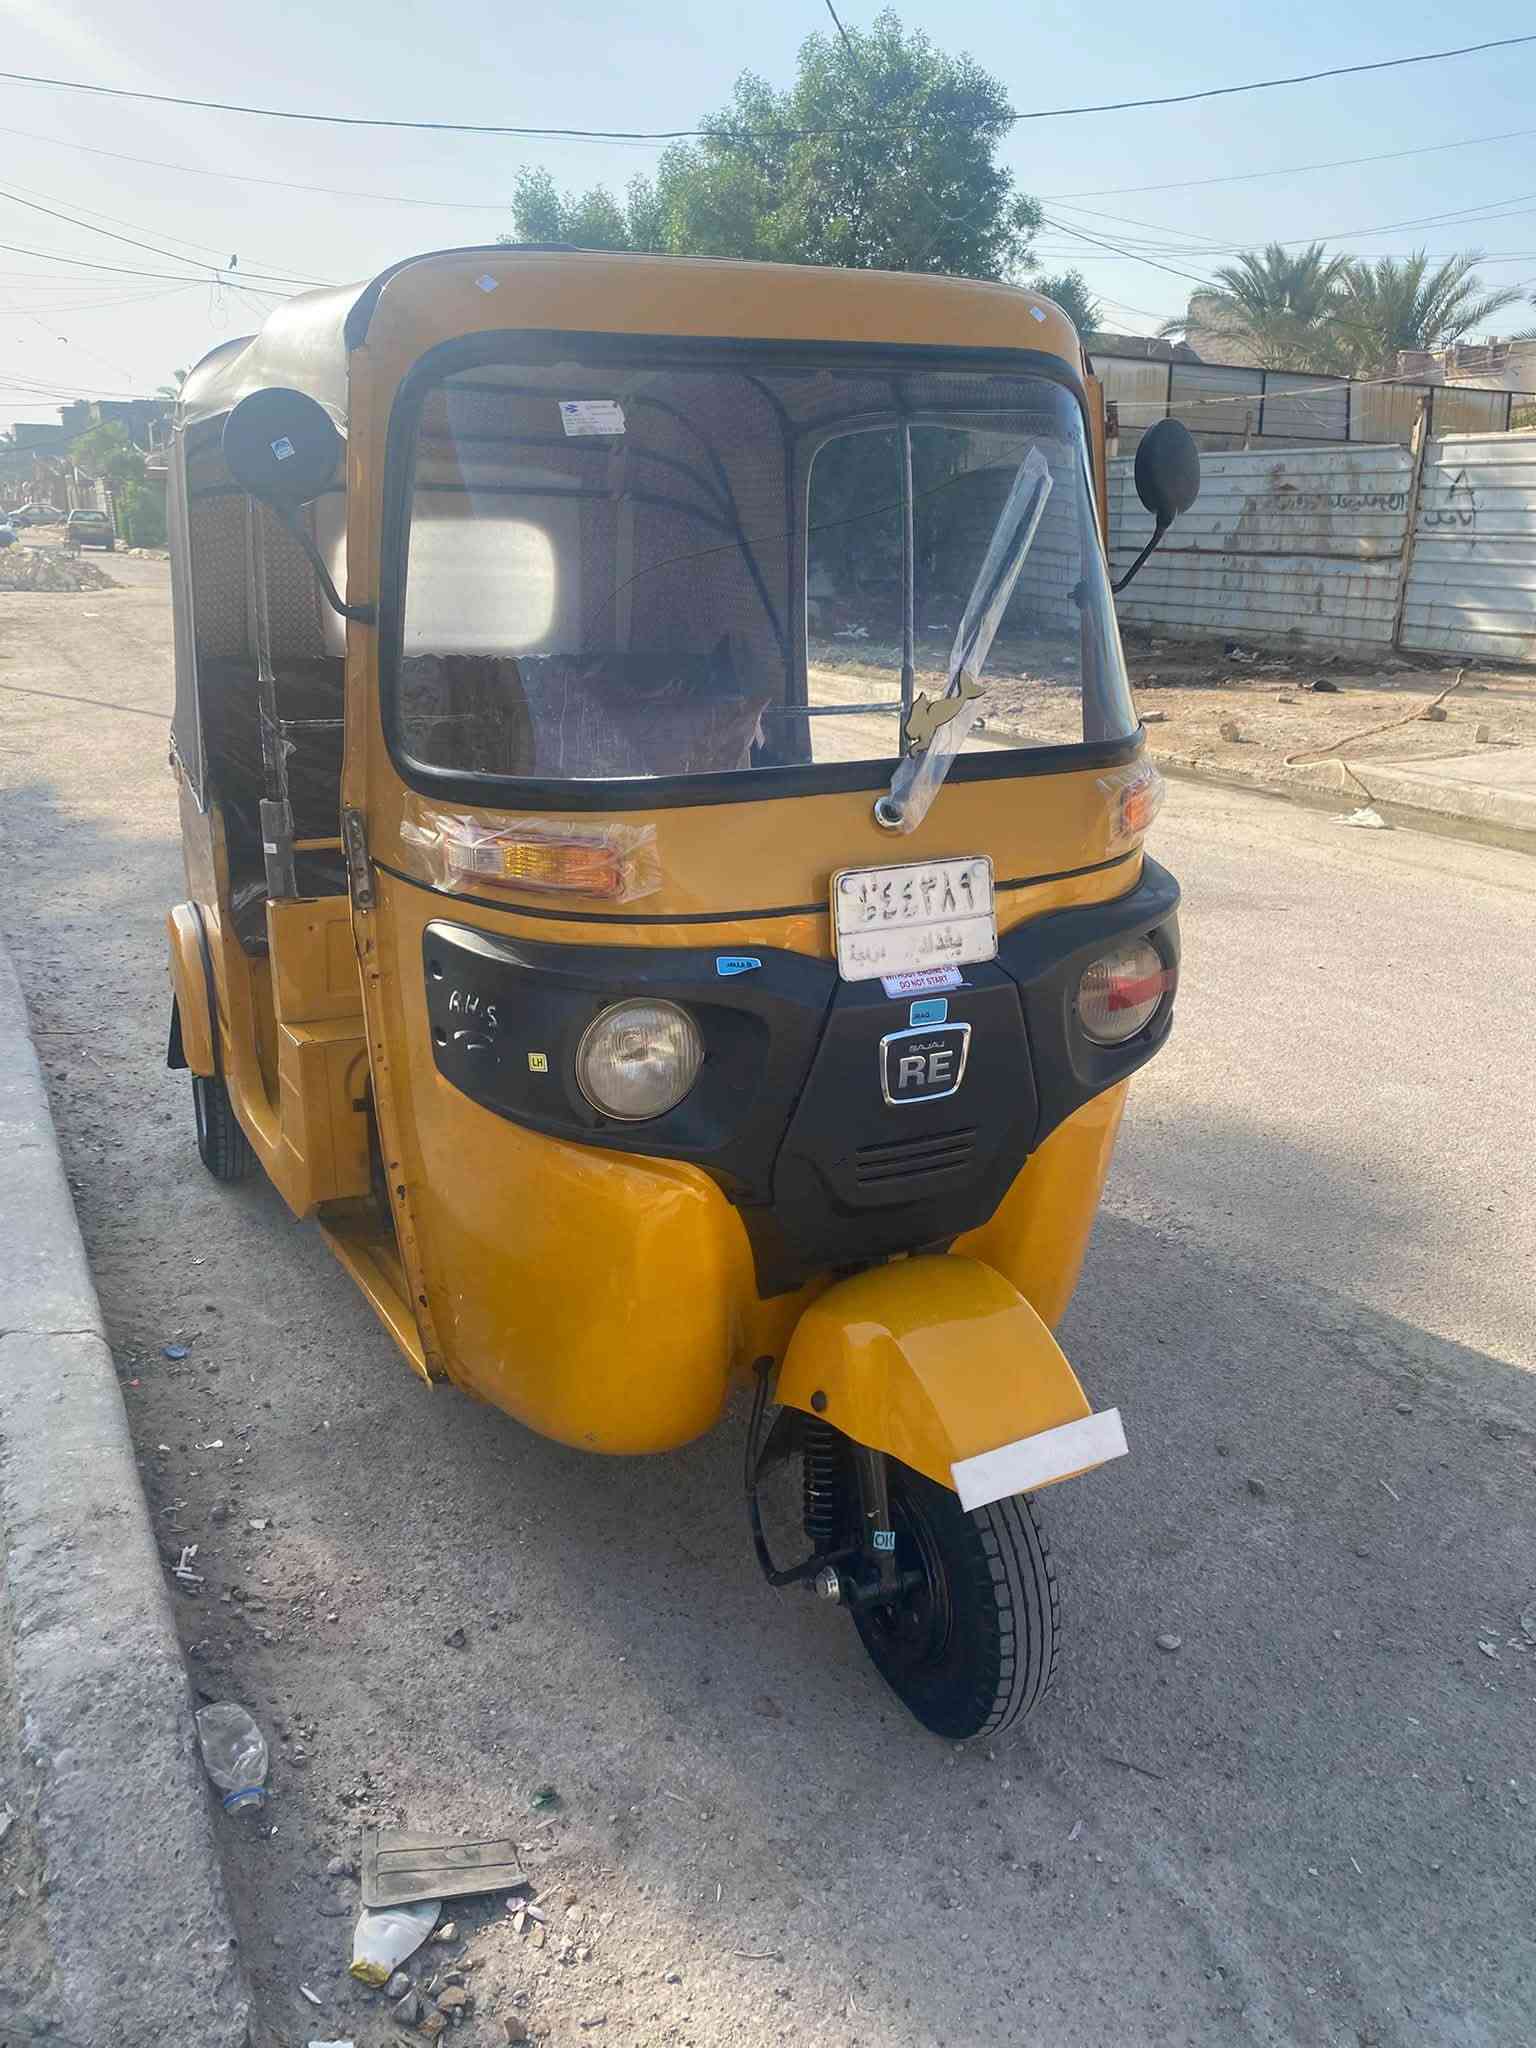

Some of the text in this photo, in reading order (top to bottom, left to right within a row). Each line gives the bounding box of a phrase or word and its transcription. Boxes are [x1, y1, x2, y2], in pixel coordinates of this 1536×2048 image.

[899, 975, 948, 989] DO NOT START
[532, 1057, 543, 1067] LH
[899, 1050, 953, 1088] RE
